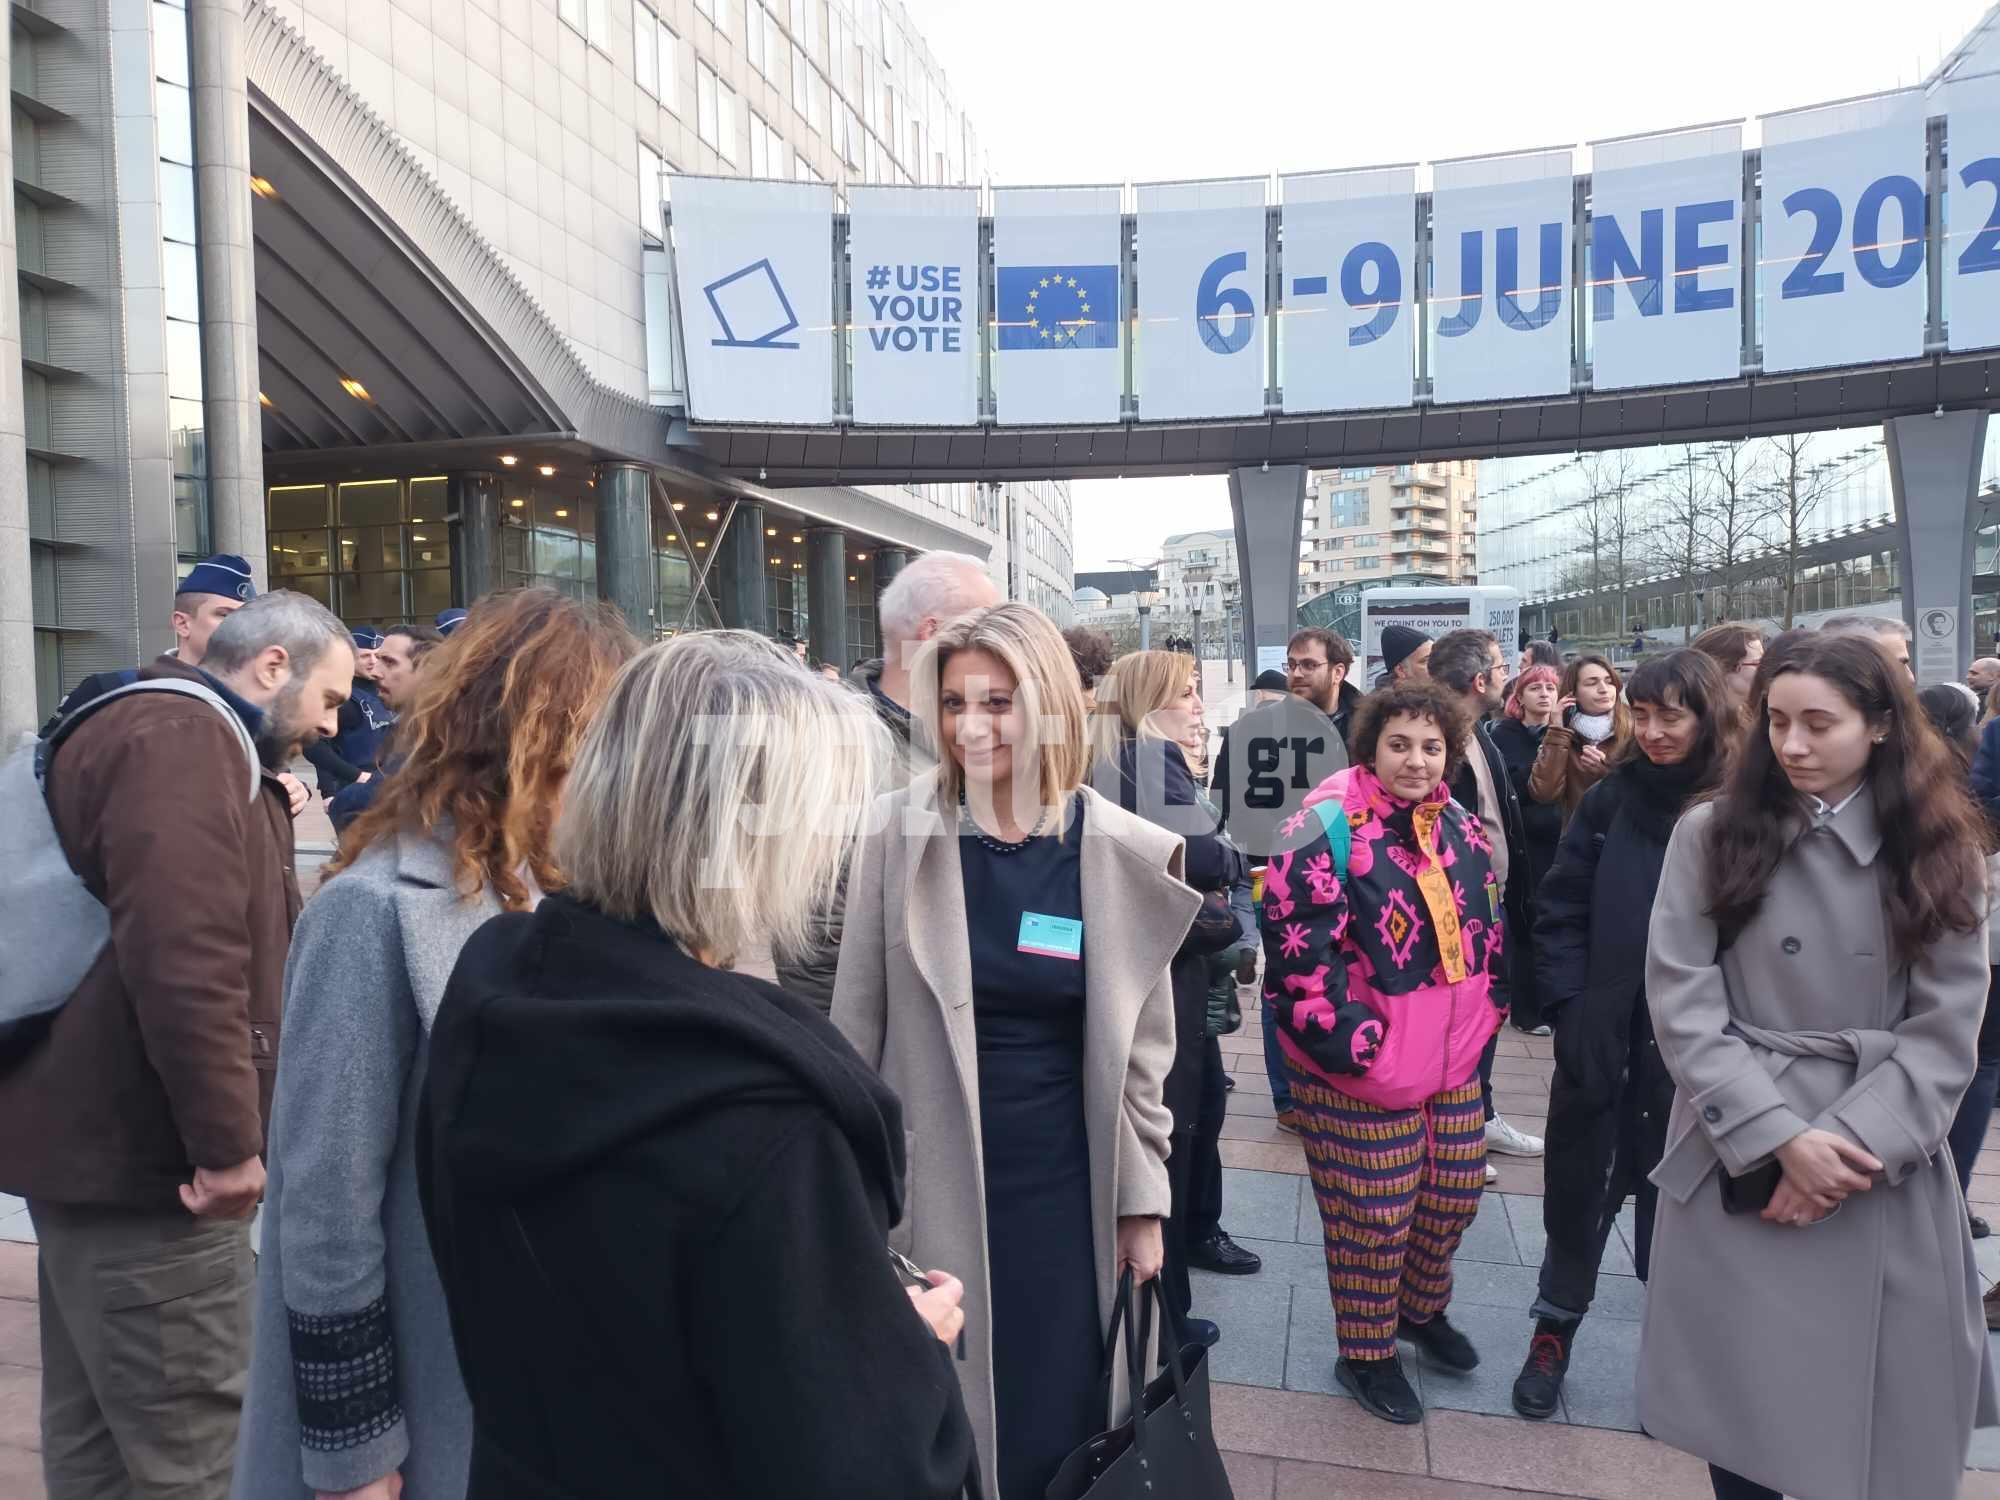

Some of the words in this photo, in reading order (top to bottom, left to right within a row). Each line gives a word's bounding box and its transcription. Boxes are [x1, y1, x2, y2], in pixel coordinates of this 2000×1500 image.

[866, 265, 961, 292] #USE
[1435, 200, 1735, 338] JUNE
[868, 295, 962, 322] YOUR
[868, 326, 961, 352] VOTE
[1375, 619, 1387, 628] WE
[1388, 619, 1415, 628] COUNT
[1417, 619, 1430, 628] ON
[1432, 619, 1449, 628] YOU
[1452, 619, 1463, 628] TO
